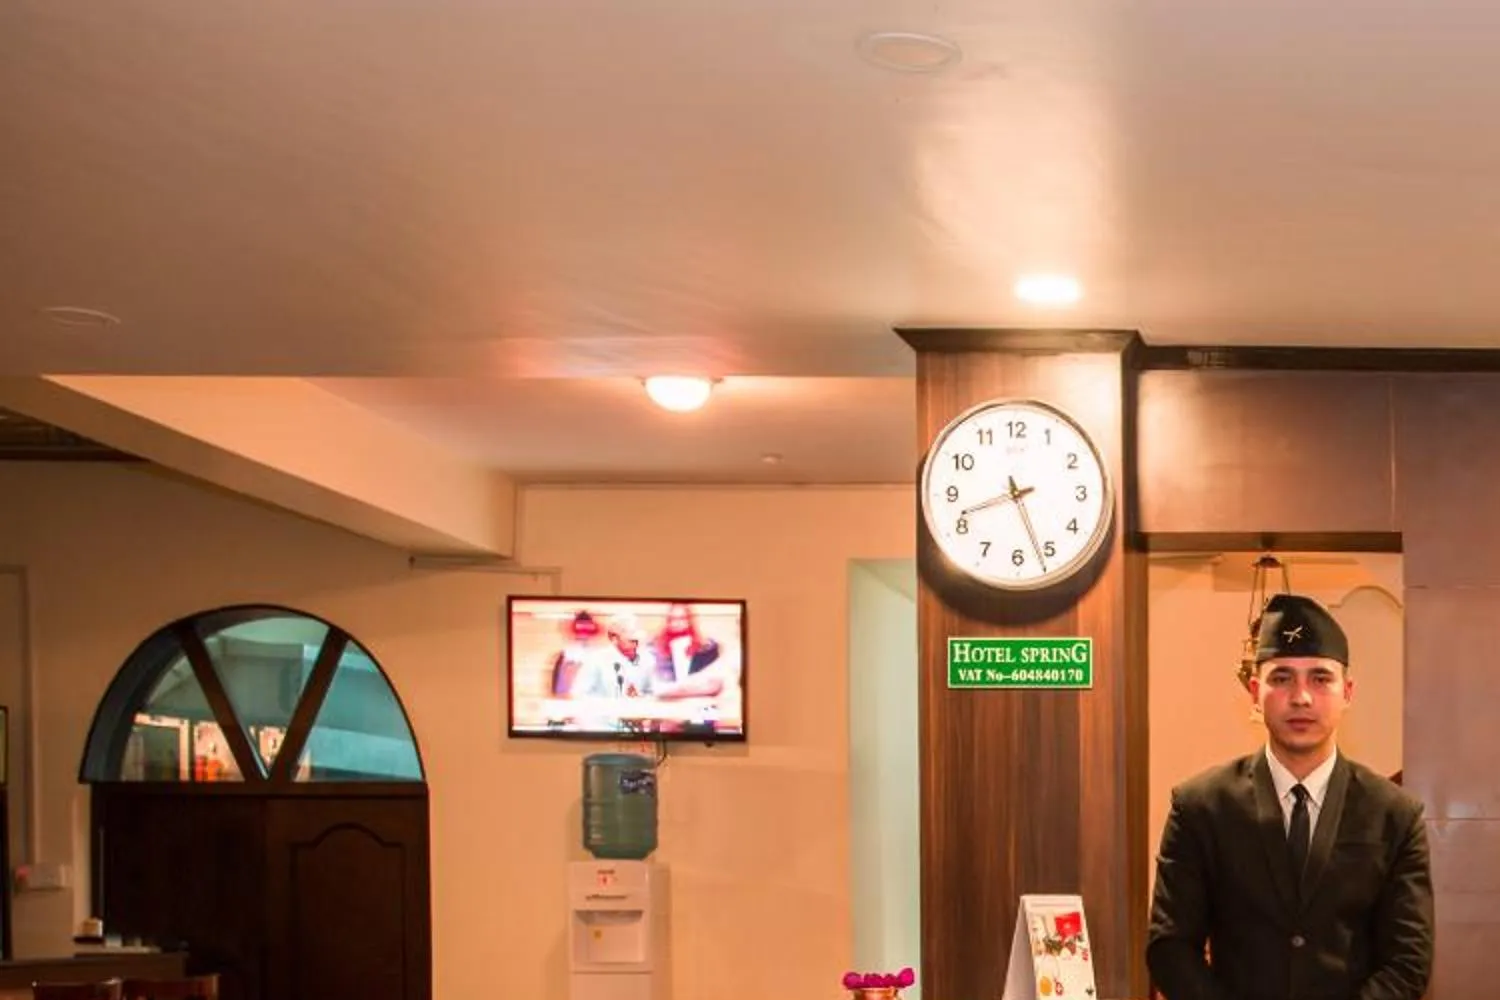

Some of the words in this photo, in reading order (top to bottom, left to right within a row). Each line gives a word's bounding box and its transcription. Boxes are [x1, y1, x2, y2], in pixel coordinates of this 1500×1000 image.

[977, 429, 993, 445] 11
[1007, 421, 1027, 439] 12
[1045, 428, 1052, 445] 1
[953, 453, 975, 471] 10
[1066, 453, 1079, 469] 2
[946, 485, 959, 502] 9
[1075, 485, 1087, 502] 3
[956, 518, 969, 535] 8
[1066, 518, 1079, 535] 4
[979, 541, 992, 557] 7
[1044, 541, 1056, 557] 5
[1012, 550, 1024, 566] 6
[958, 669, 983, 681] VAT
